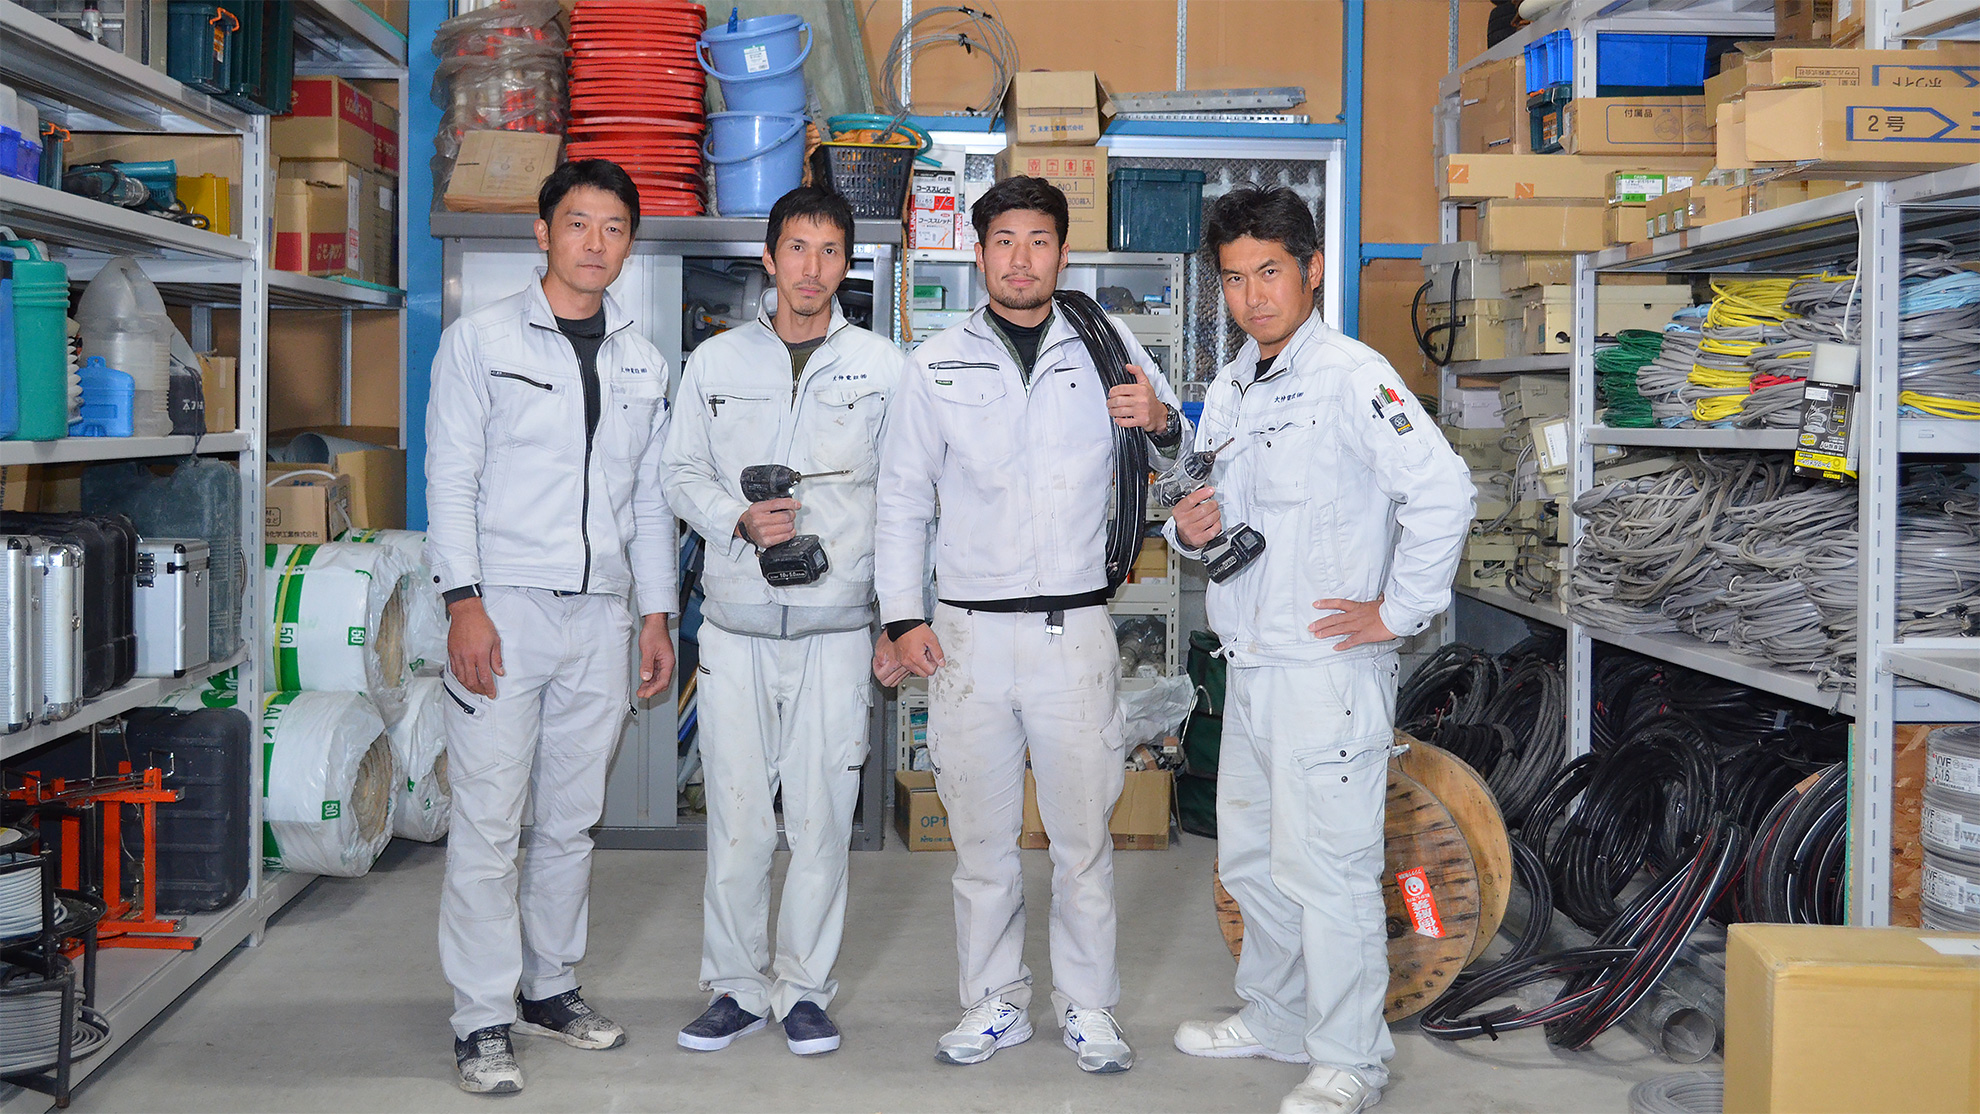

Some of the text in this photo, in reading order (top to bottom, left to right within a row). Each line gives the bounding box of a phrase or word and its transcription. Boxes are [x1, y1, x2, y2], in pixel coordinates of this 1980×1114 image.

[1892, 77, 1942, 88] ホワイト
[1624, 109, 1653, 118] 付属品
[351, 629, 365, 644] 50
[1935, 754, 1952, 767] VVF
[324, 803, 339, 817] 50
